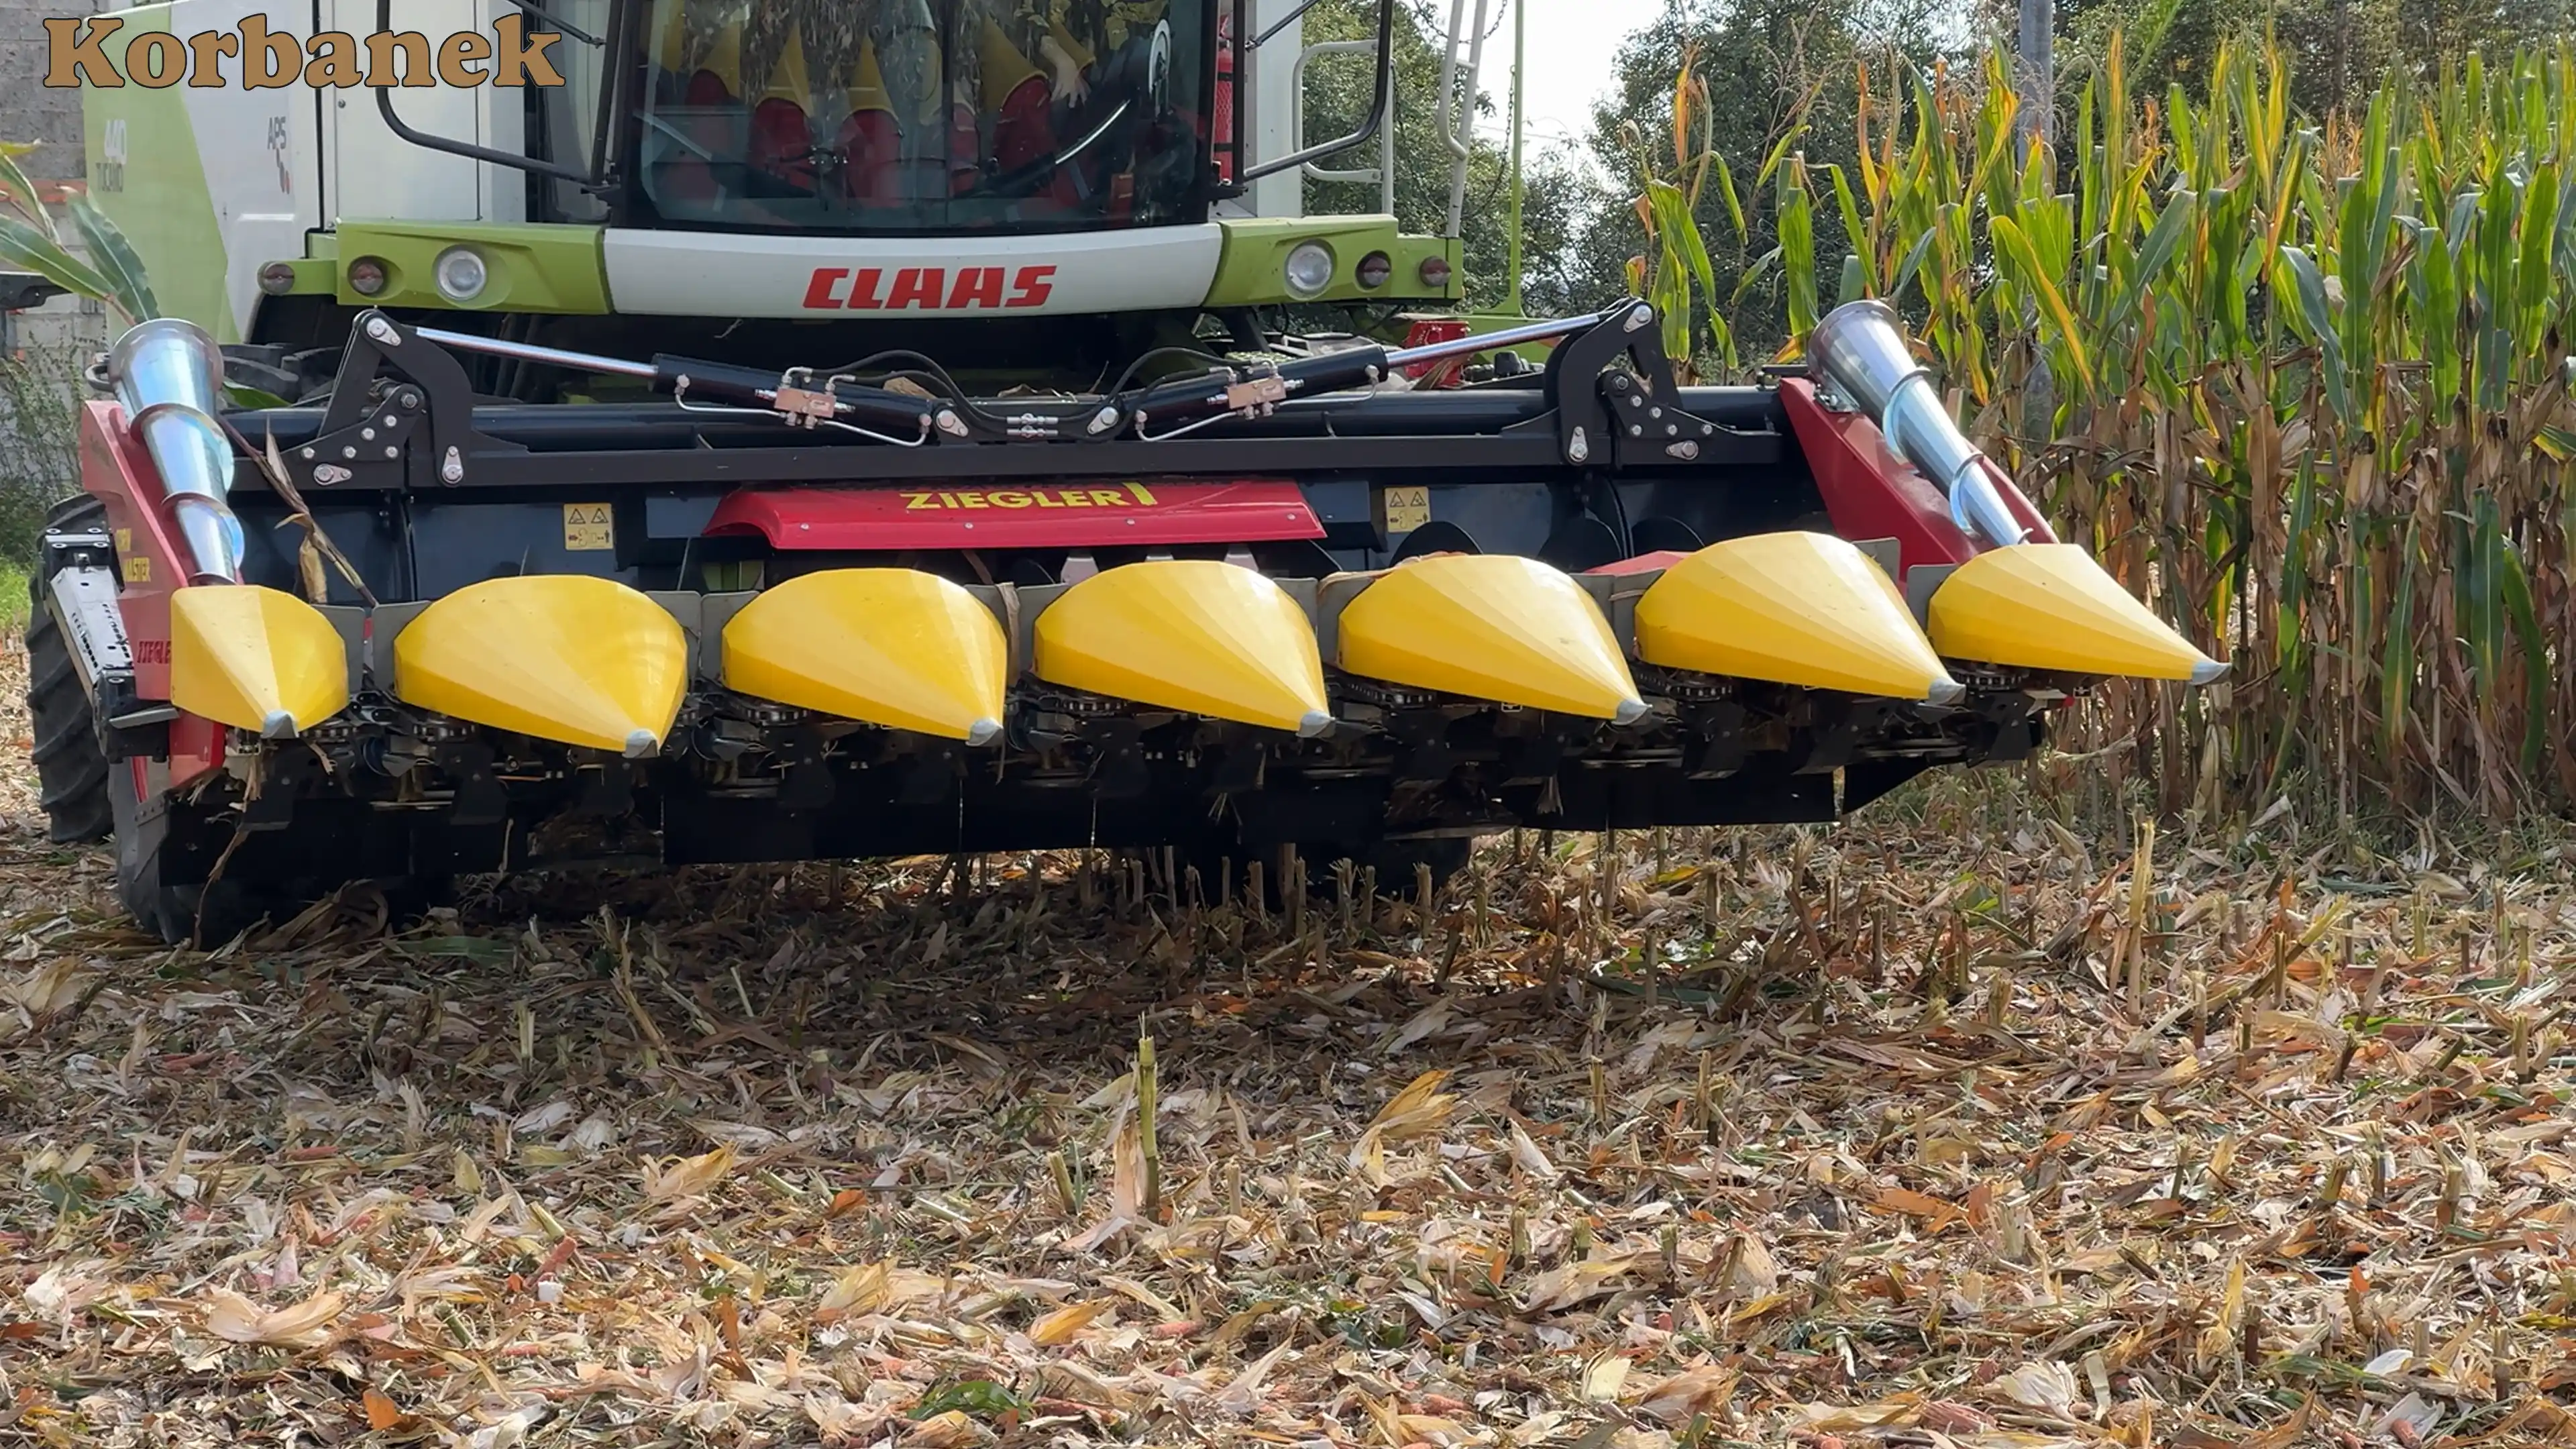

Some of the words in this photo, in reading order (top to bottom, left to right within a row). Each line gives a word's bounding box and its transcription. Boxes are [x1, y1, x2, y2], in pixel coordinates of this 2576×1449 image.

[104, 119, 127, 165] 440
[267, 116, 286, 150] APS
[803, 265, 1057, 309] CLAAS
